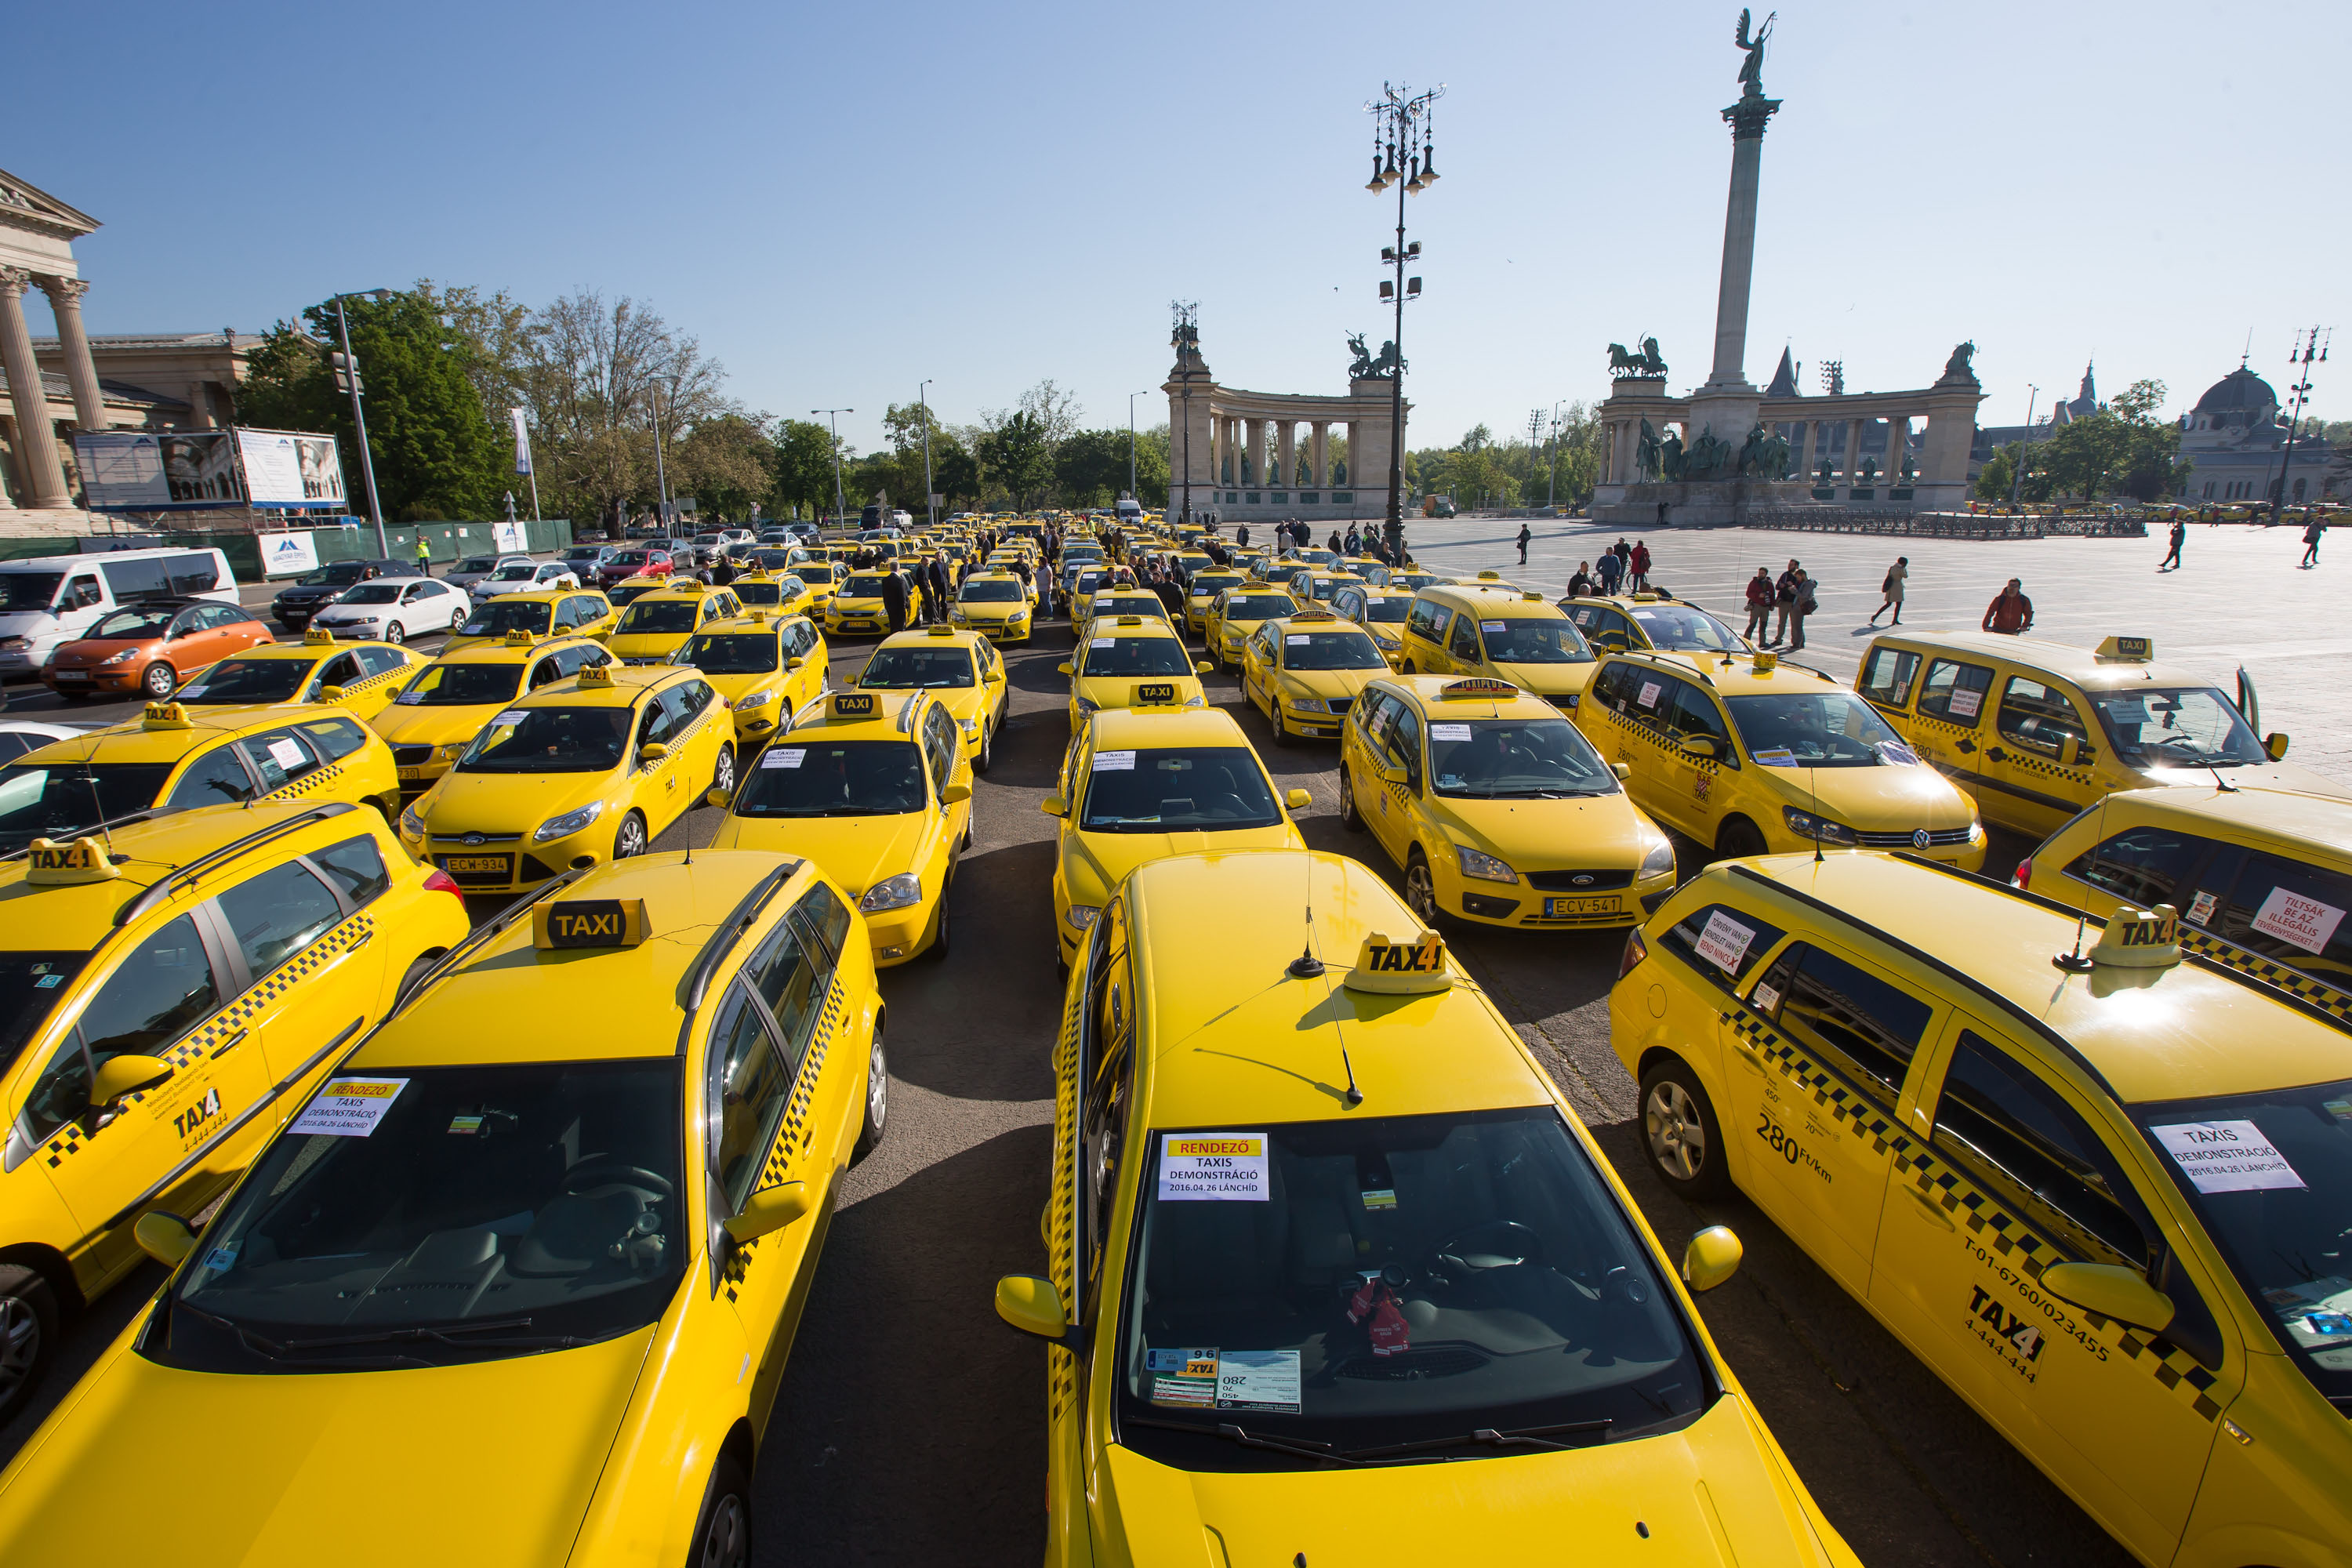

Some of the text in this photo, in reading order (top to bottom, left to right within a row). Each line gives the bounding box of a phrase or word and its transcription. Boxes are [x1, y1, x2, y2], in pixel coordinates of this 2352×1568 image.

[2120, 640, 2144, 650] TAXI
[1461, 679, 1504, 688] TAXIPLUS
[1142, 687, 1171, 697] TAXI
[839, 697, 869, 710] TAXI
[1617, 746, 1631, 763] 280
[397, 770, 416, 779] 730
[449, 858, 504, 870] ECW-934
[1556, 898, 1616, 913] ECV-541
[2285, 896, 2326, 917] TILTSÁK
[2283, 907, 2315, 924] BE AZ
[555, 913, 619, 937] TAXI
[1711, 917, 1743, 941] TÖRVÉNY VAN
[2256, 919, 2313, 946] TEVÉKENYSÉGEKET
[2268, 913, 2319, 937] ILLEGÁLIS
[1703, 927, 1736, 952] RENDELET VAN
[1699, 939, 1730, 964] REND NINCS
[332, 1084, 387, 1095] RENDEZŐ
[1764, 1088, 1779, 1103] 450
[336, 1098, 366, 1107] TAXIS
[307, 1109, 377, 1119] DEMONSTRÁCIÓ
[336, 1119, 368, 1129] LÁNCHÍD
[1805, 1120, 1816, 1134] 70
[2183, 1129, 2238, 1144] TAXIS
[1180, 1140, 1249, 1154] RENDEZŐ
[1756, 1112, 1798, 1165] 280
[1799, 1147, 1831, 1184] Ft/km
[2173, 1145, 2278, 1163] DEMONSTRÁCIÓ
[1196, 1157, 1232, 1167] TAXIS
[2189, 1162, 2288, 1177] 2016.04.26 LÁNCHÍD
[1170, 1169, 1258, 1180] DEMONSTRÁCIÓ
[1219, 1182, 1258, 1192] LÁNCHÍD
[1963, 1235, 2111, 1363] T-01-6760/023455
[1964, 1319, 2037, 1384] 4-444-444
[1222, 1376, 1247, 1385] 280
